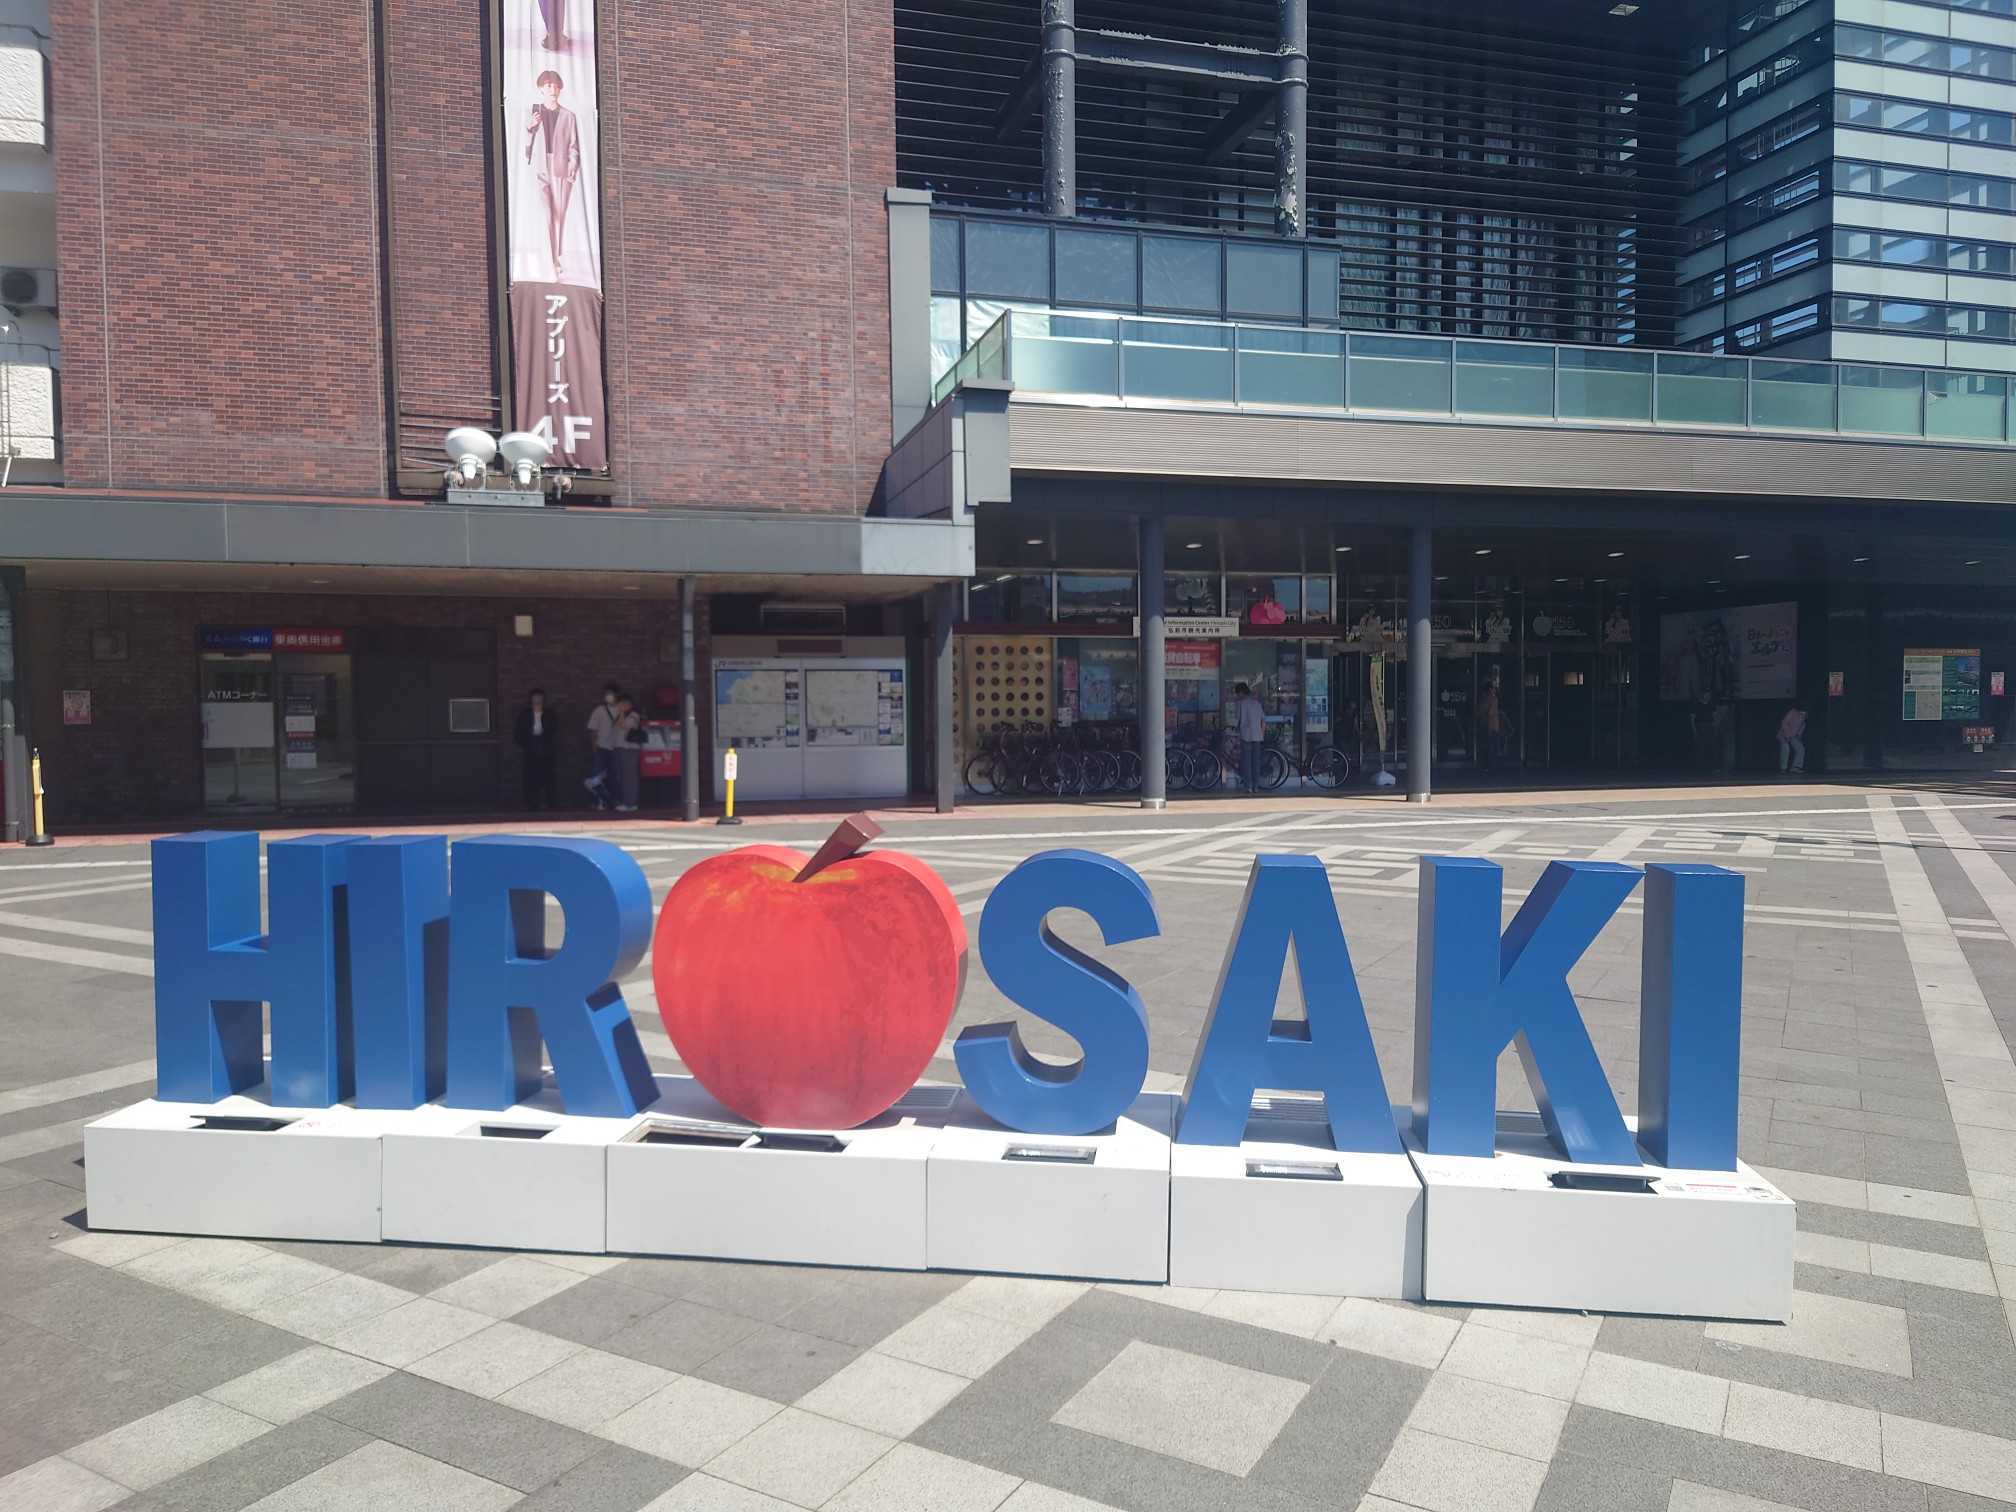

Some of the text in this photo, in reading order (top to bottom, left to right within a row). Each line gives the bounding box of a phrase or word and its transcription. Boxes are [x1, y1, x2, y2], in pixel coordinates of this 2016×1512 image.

[544, 294, 569, 404] アプリーズ
[531, 415, 593, 455] 4F
[207, 689, 268, 700] ATMコーナー
